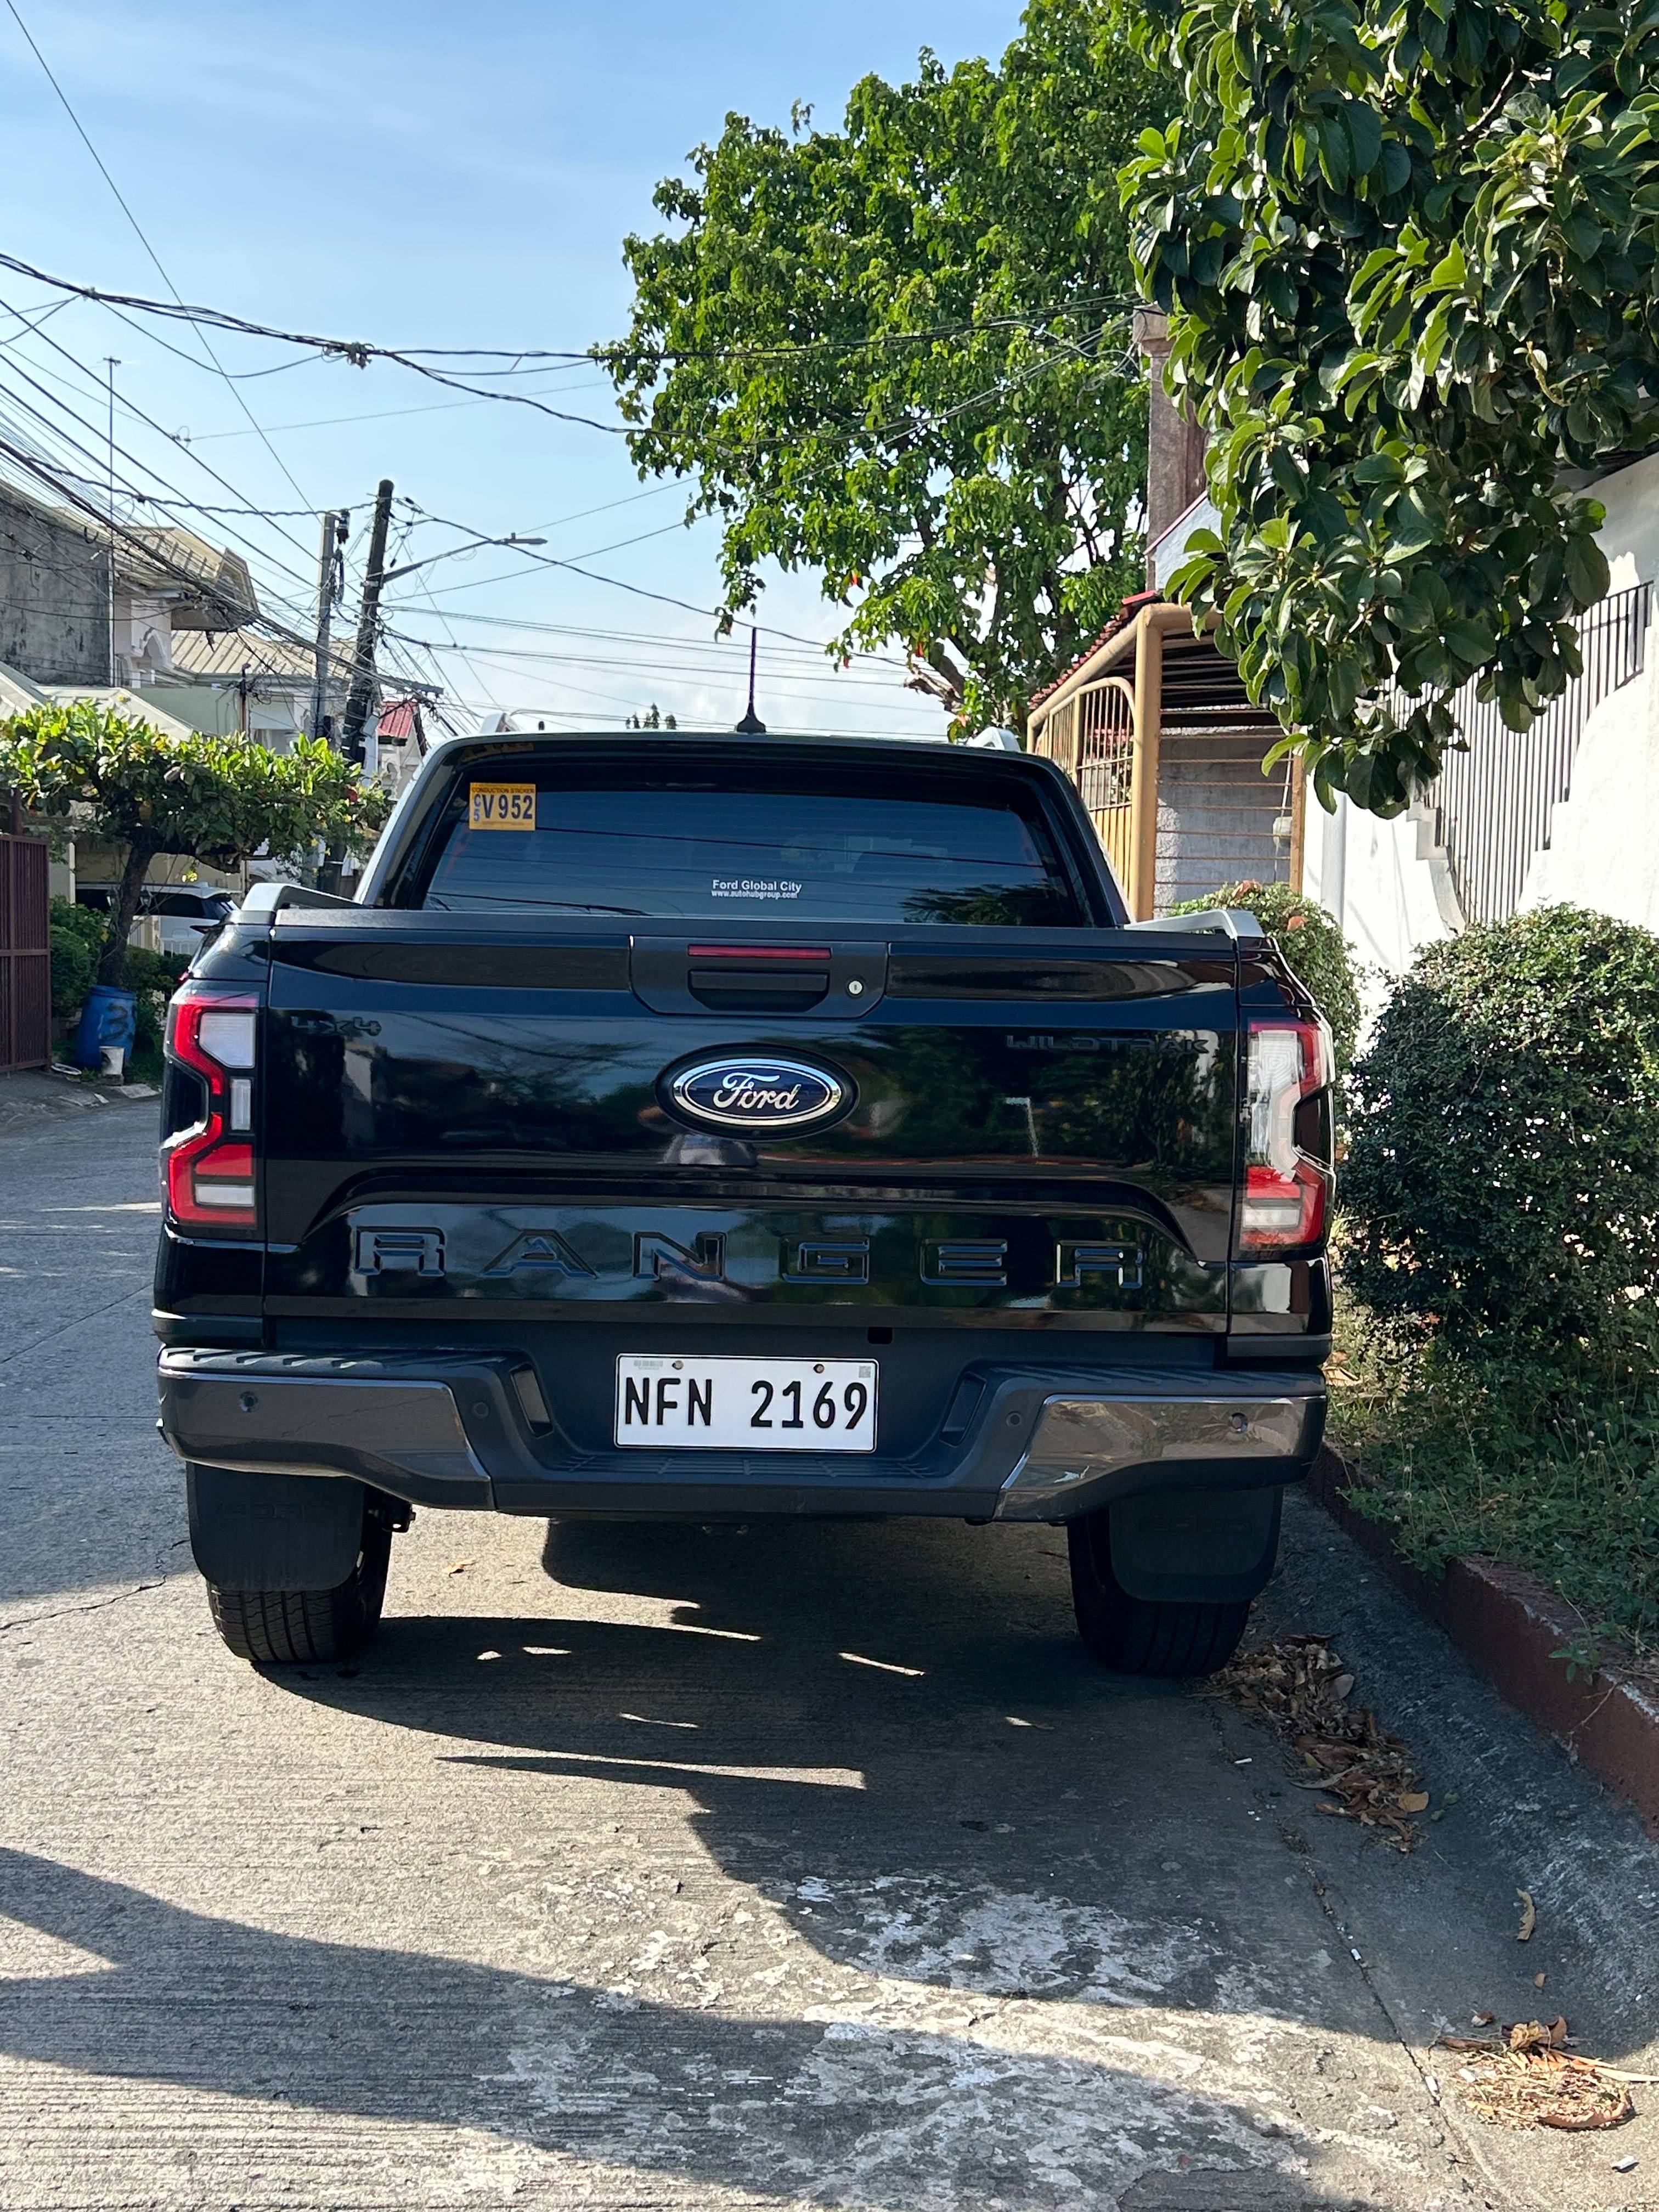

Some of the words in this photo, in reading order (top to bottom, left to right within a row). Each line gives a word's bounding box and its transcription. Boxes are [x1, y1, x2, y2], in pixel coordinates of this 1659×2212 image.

[711, 890, 798, 900] www.autohubgroup.com
[713, 879, 738, 890] Ford
[741, 880, 776, 890] Global
[780, 881, 802, 893] City
[1005, 1035, 1210, 1054] WILDTRAK
[713, 1073, 802, 1110] Ford
[356, 1226, 1143, 1288] RANGER
[625, 1377, 712, 1426] NFN
[750, 1380, 868, 1430] 2169
